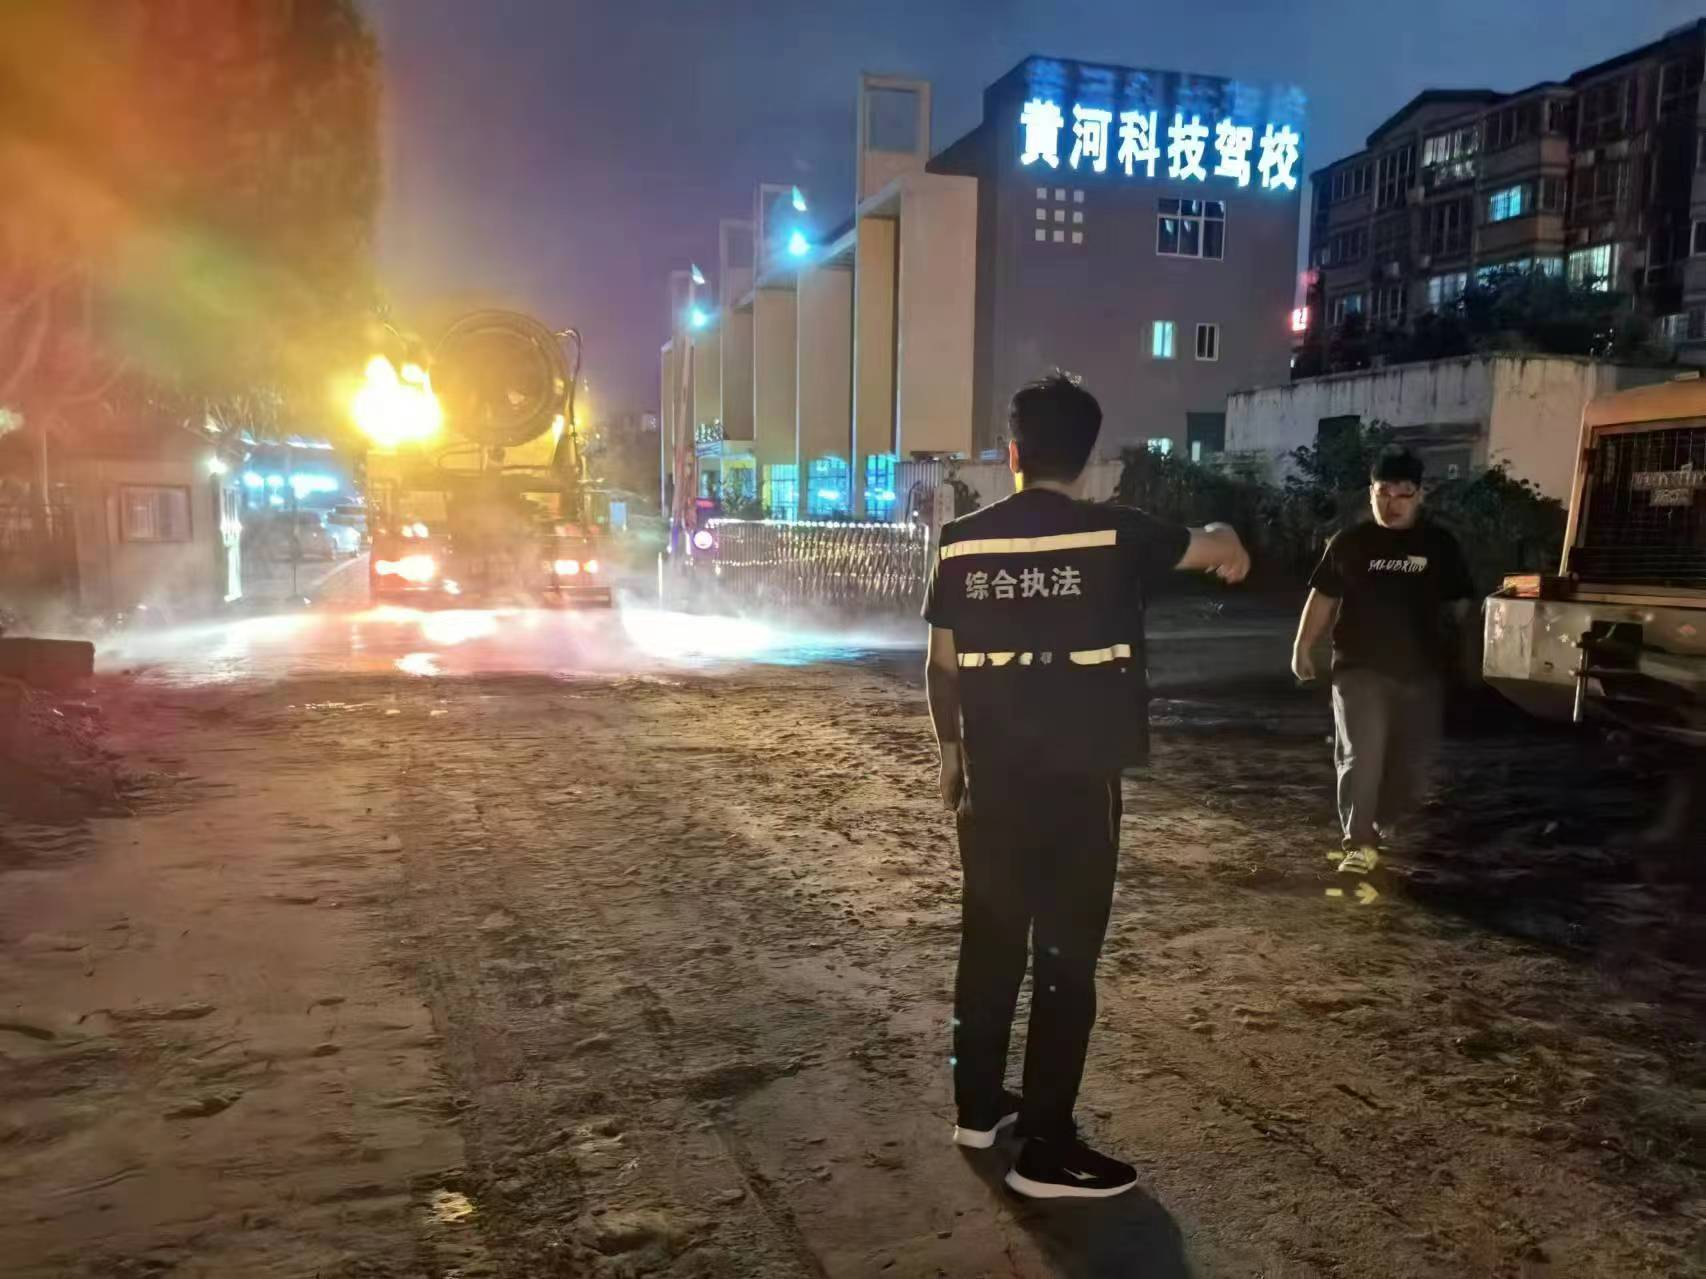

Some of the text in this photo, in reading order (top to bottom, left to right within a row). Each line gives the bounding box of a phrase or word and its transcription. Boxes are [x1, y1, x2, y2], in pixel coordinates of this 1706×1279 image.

[1020, 98, 1299, 190] 黄河科技驾校
[965, 565, 1082, 600] 综合执法
